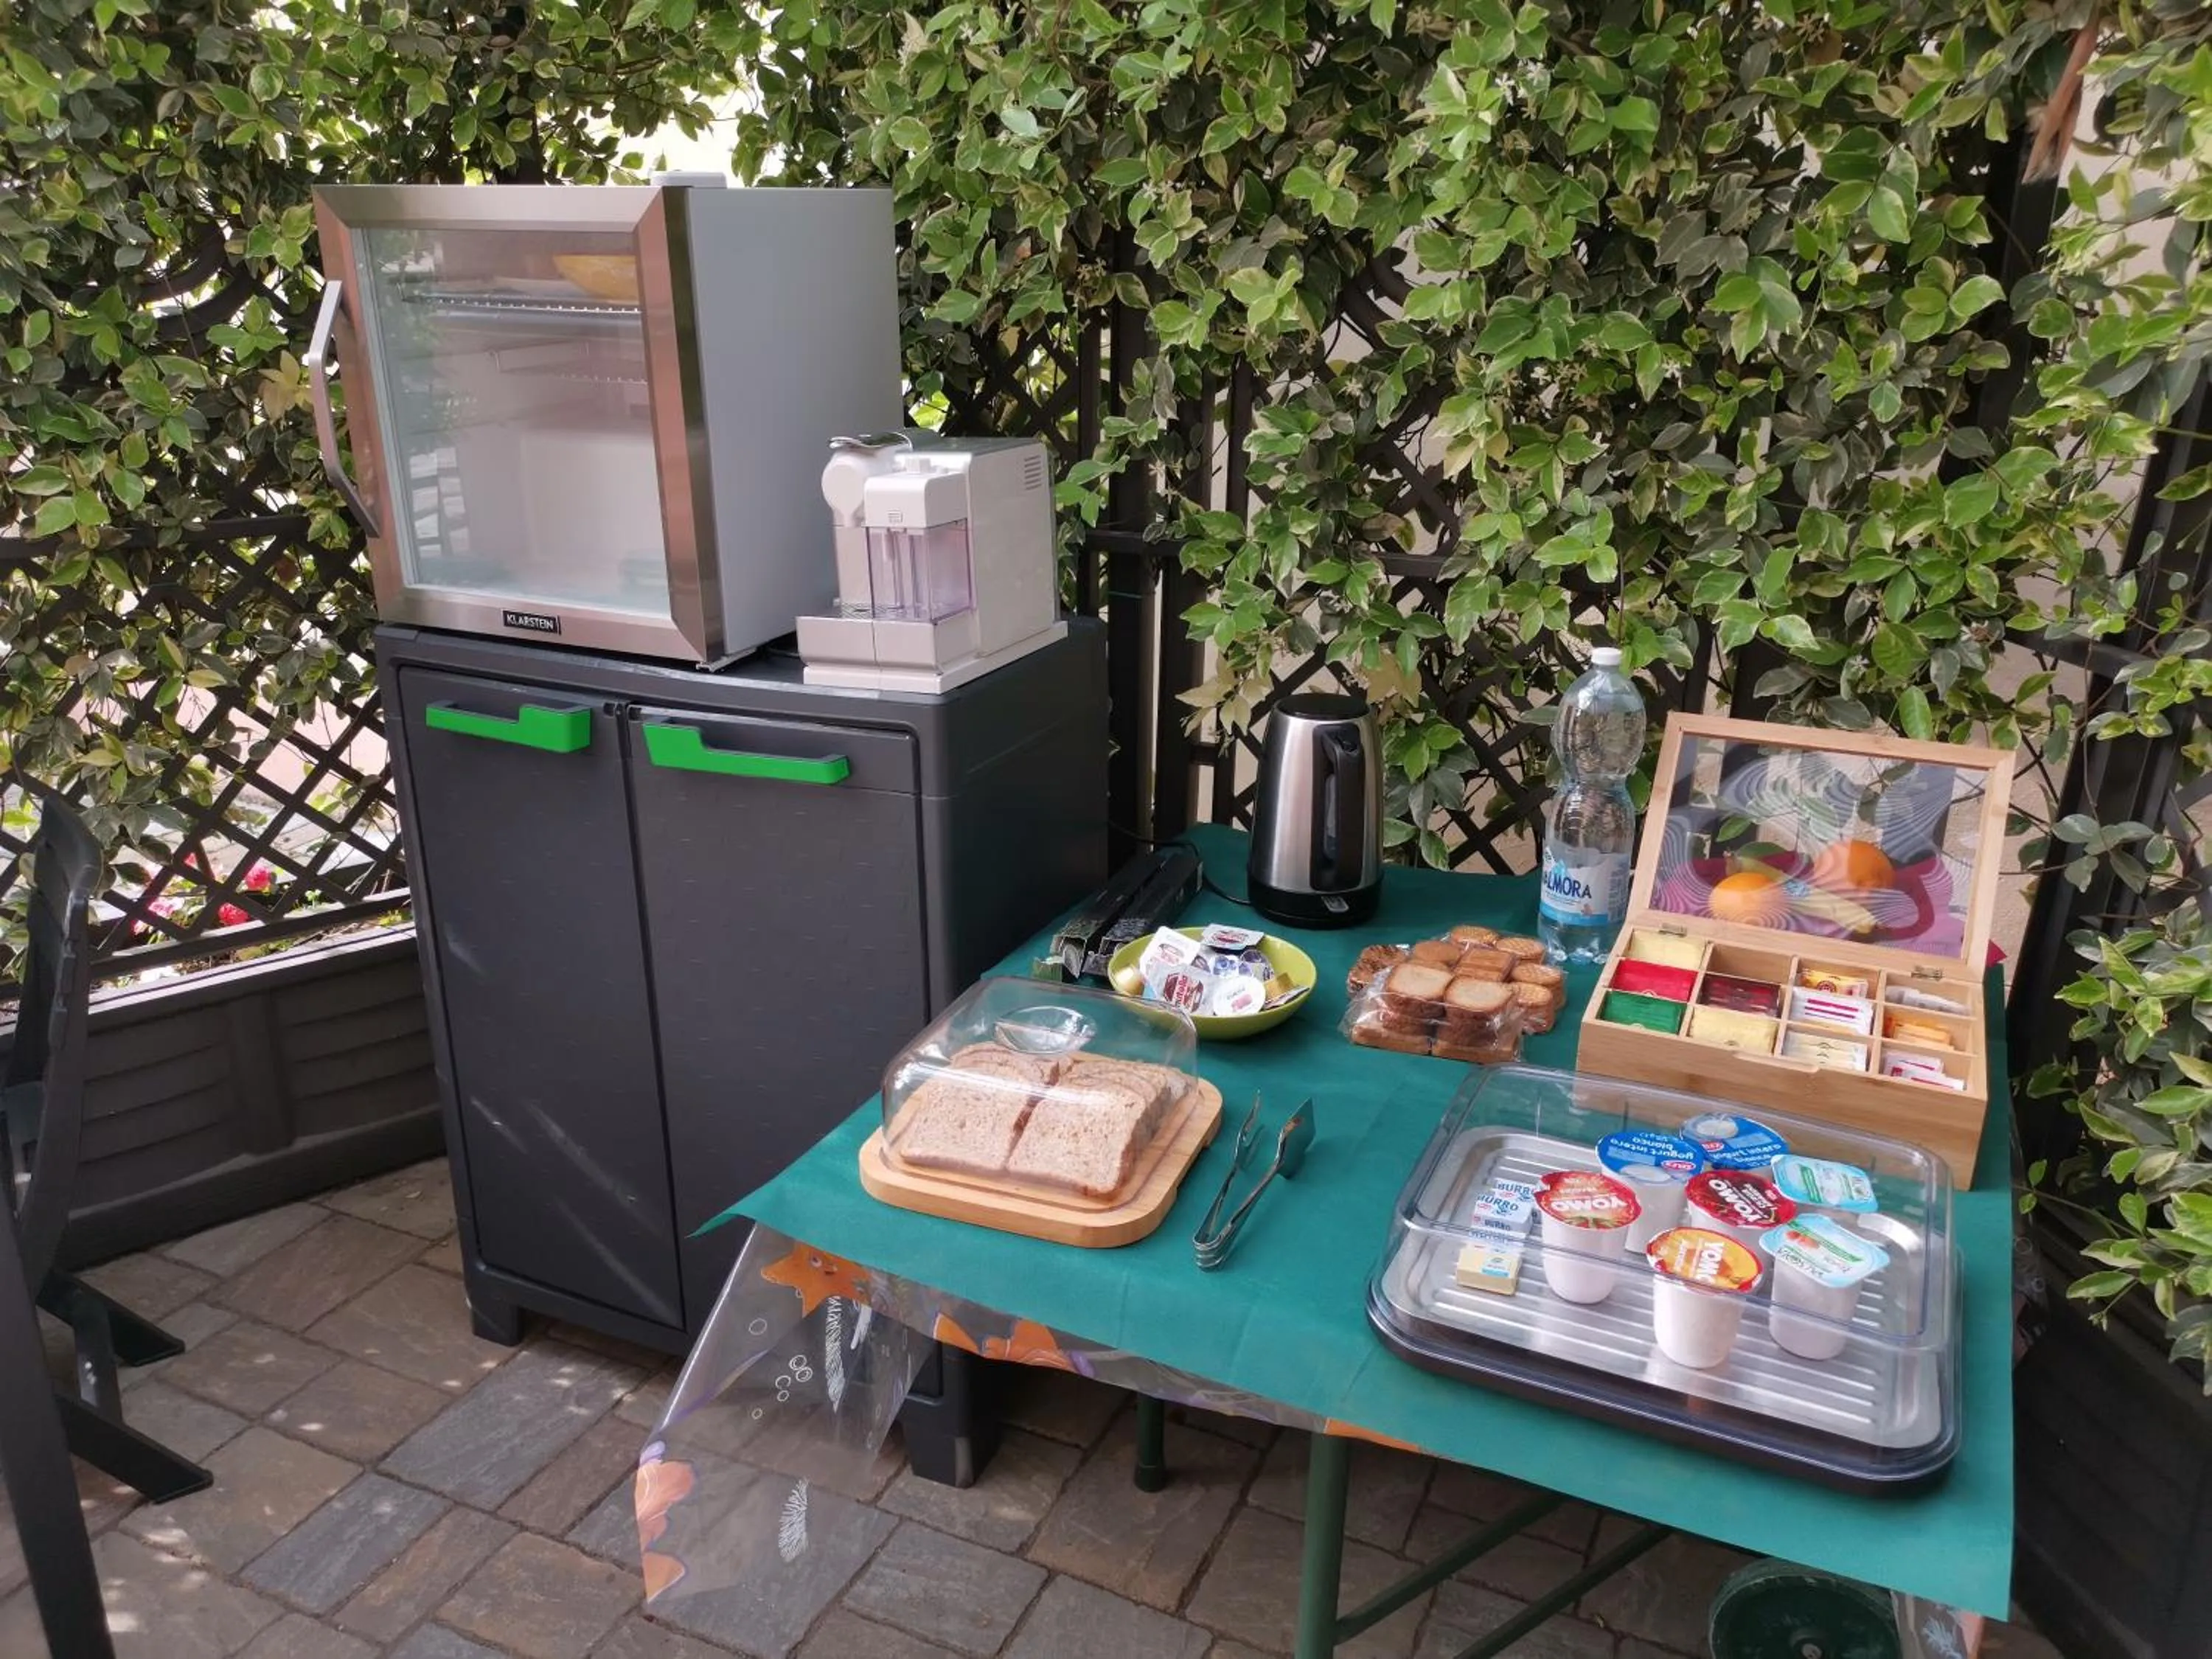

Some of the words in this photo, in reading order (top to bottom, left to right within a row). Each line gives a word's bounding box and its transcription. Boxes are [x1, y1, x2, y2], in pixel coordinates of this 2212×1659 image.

[507, 613, 554, 630] KLARSTEIN
[1610, 1138, 1648, 1154] intero
[1650, 1148, 1694, 1160] yogurt
[1551, 1194, 1629, 1211] YOMO
[1708, 1179, 1762, 1222] YOMO
